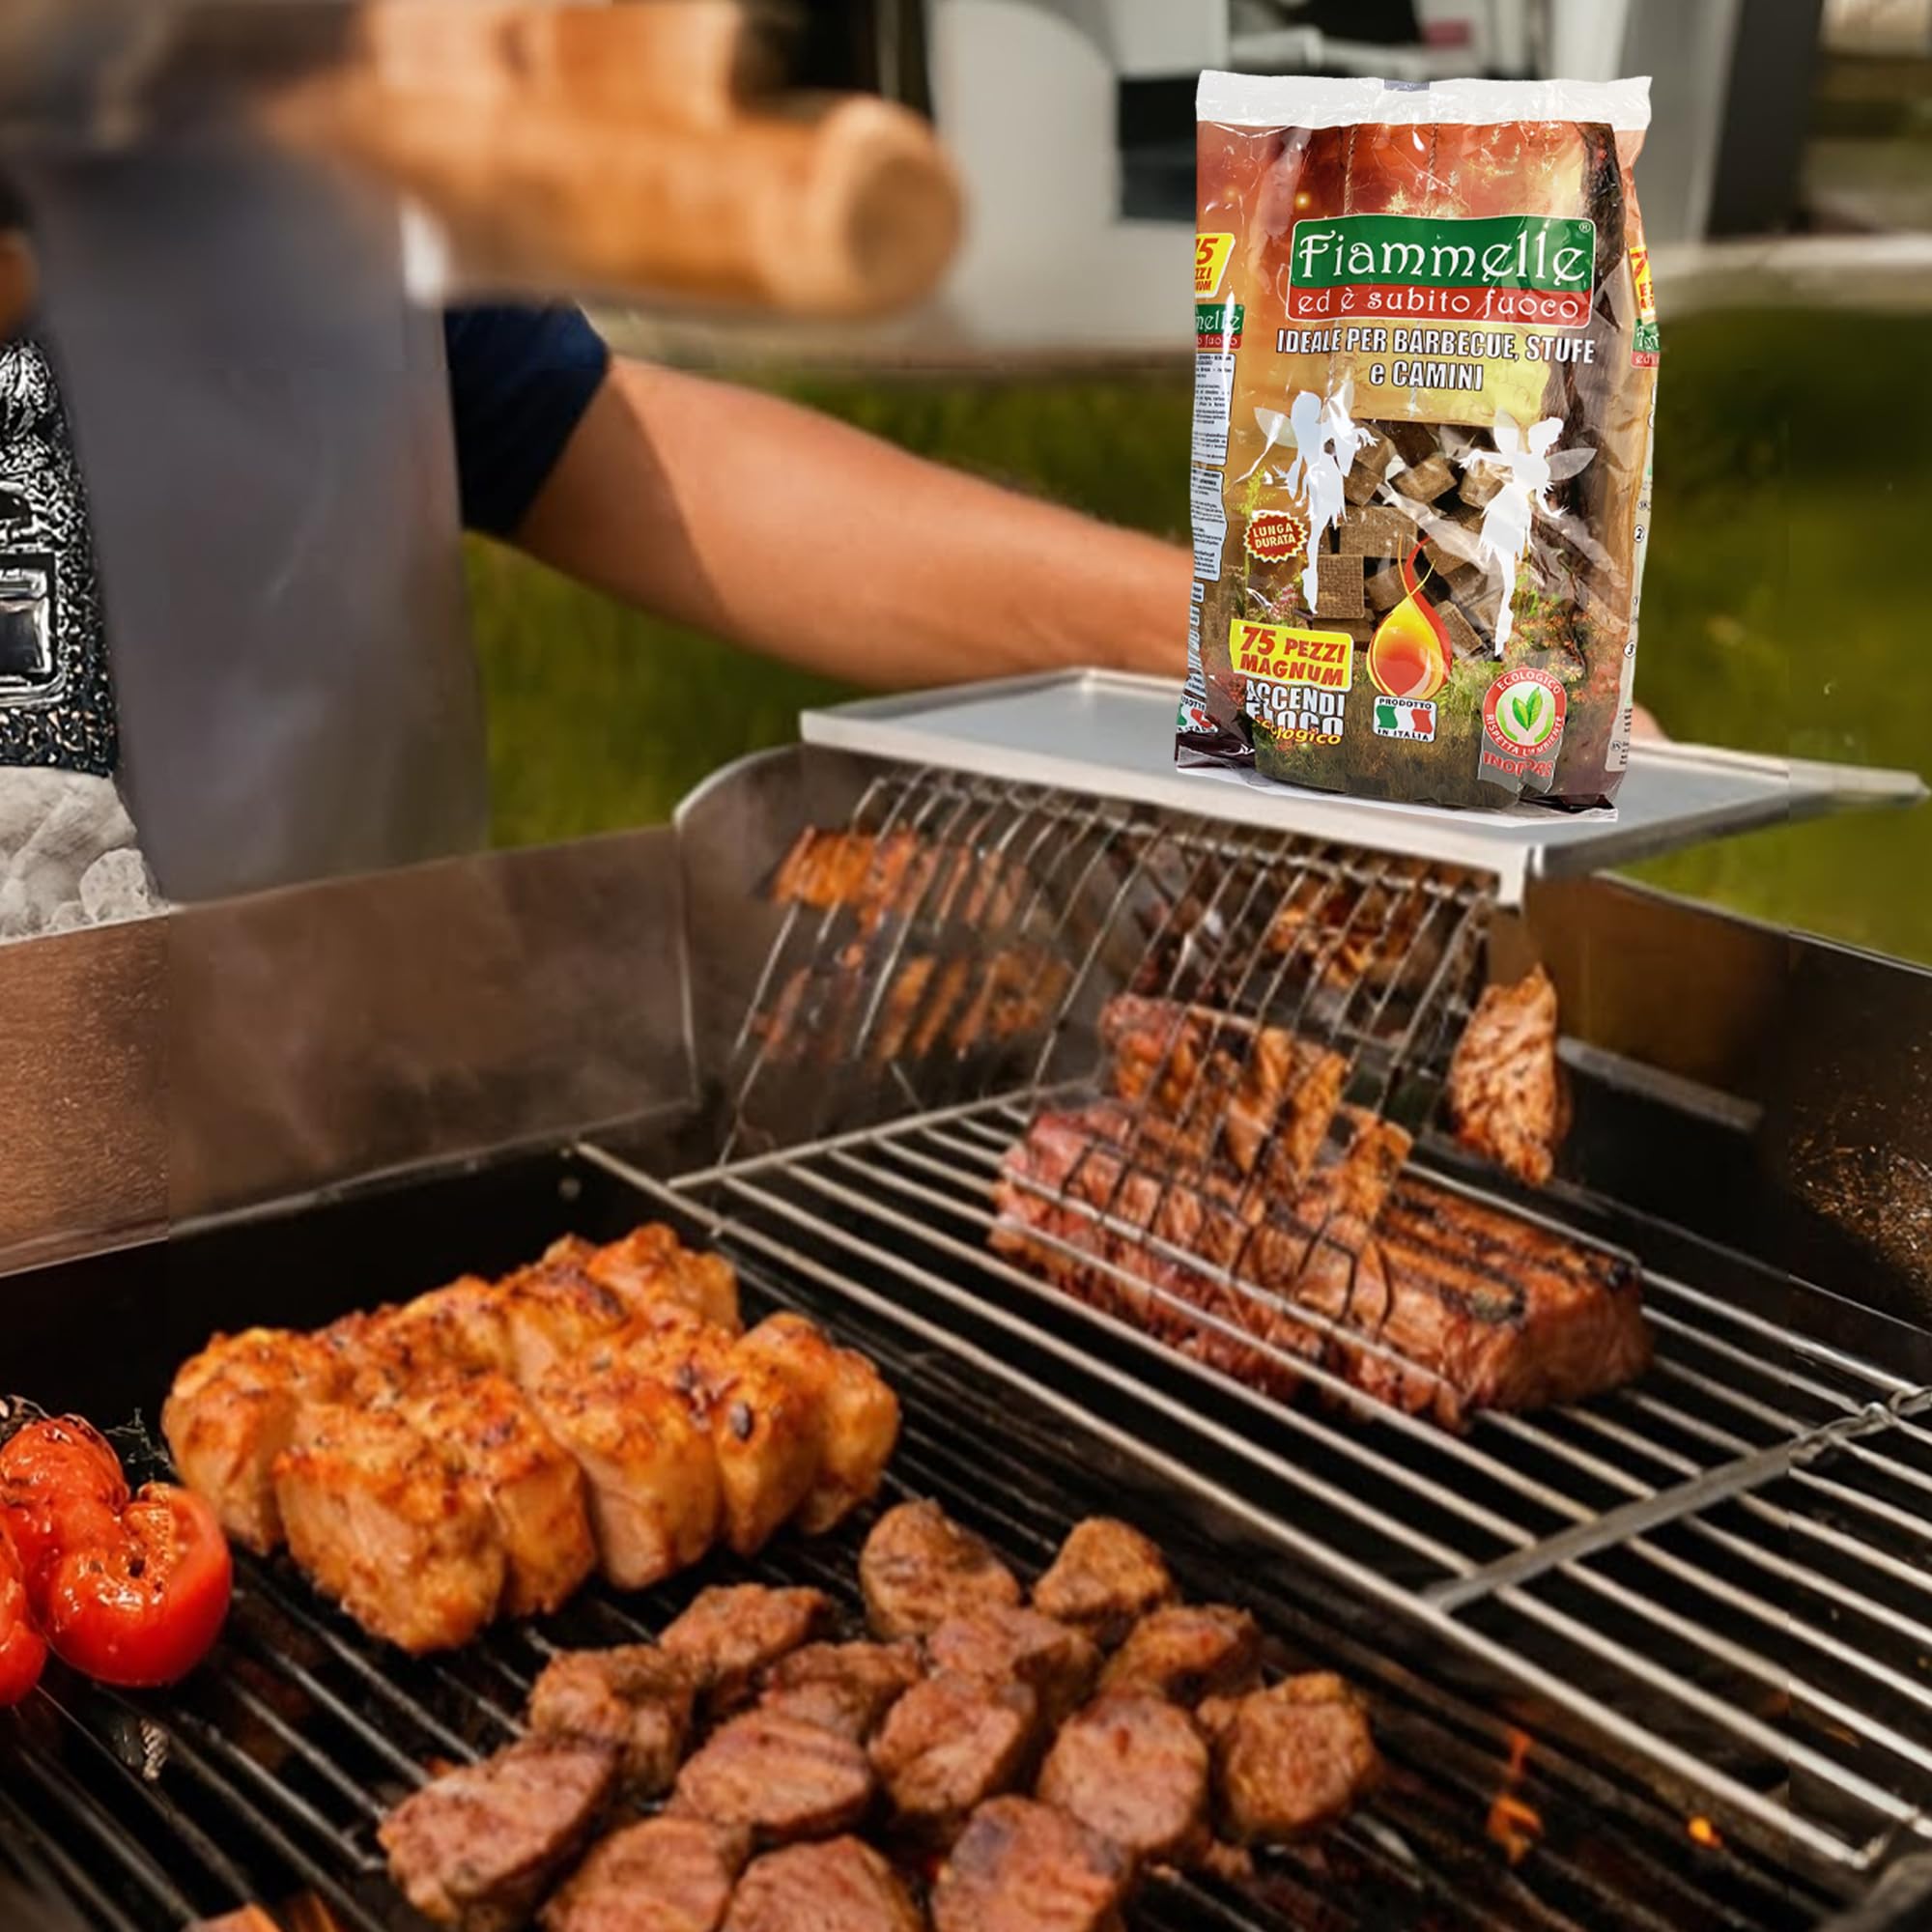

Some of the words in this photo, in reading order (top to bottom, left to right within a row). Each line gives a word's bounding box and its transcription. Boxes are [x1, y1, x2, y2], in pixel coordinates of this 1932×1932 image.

[1298, 229, 1585, 286] Fiammelle
[1297, 289, 1331, 315] ed
[1340, 287, 1355, 313] è
[1367, 287, 1470, 313] subito
[1483, 290, 1578, 319] fuoco
[1276, 328, 1341, 354] IDEALE
[1347, 327, 1386, 353] PER
[1392, 329, 1520, 361] BARBECUE,
[1525, 335, 1595, 364] STUFE
[1369, 363, 1385, 386] e
[1392, 360, 1484, 391] CAMINI
[1252, 523, 1293, 538] LUNGA
[1254, 533, 1296, 549] DURATA
[1240, 625, 1277, 656] 75
[1283, 638, 1347, 664] PEZZI
[1239, 653, 1344, 687] MAGNUM
[1496, 670, 1562, 695] ECOLOGICO
[1246, 679, 1346, 717] ACCENDI
[1378, 697, 1432, 710] PRODOTTO
[1393, 730, 1429, 741] ITALIA
[1486, 714, 1519, 755] RISPETTA
